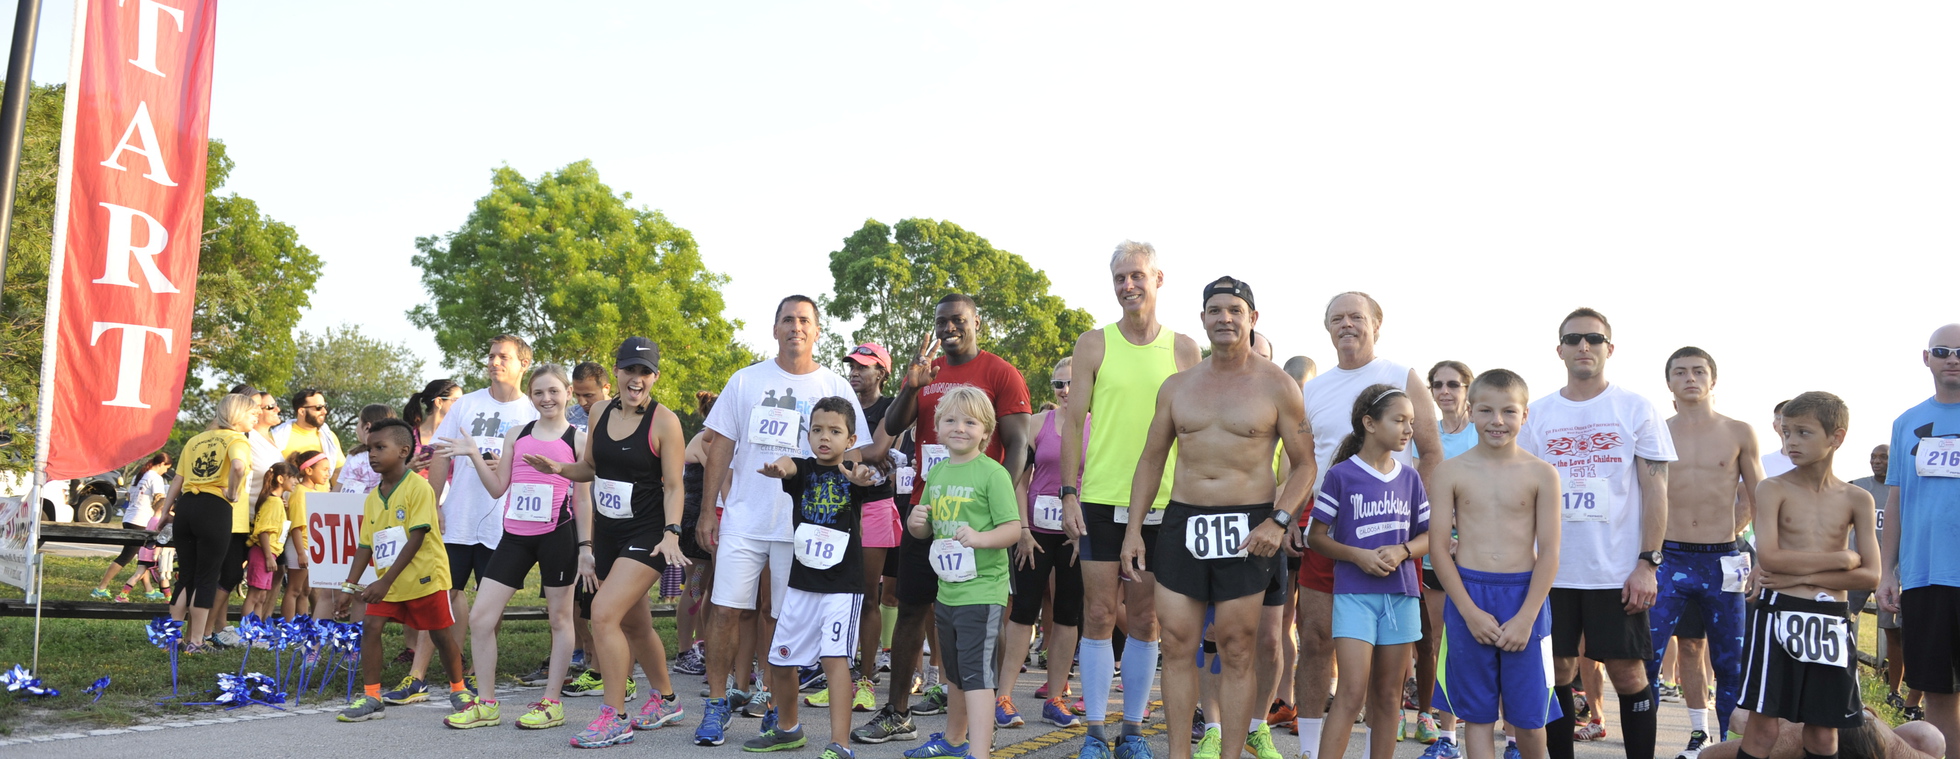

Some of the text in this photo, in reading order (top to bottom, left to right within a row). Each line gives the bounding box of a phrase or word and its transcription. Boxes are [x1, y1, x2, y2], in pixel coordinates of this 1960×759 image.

[759, 419, 789, 436] 207
[1593, 454, 1622, 463] Children
[1927, 451, 1960, 467] 216
[598, 491, 621, 510] 226
[947, 485, 974, 498] NOT
[1562, 492, 1595, 509] 178
[516, 495, 541, 512] 210
[931, 494, 976, 521] UST
[1194, 515, 1241, 557] 815
[375, 540, 397, 560] 227
[805, 538, 835, 559] 118
[937, 553, 963, 571] 117
[831, 621, 842, 642] 9
[1786, 614, 1840, 663] 805
